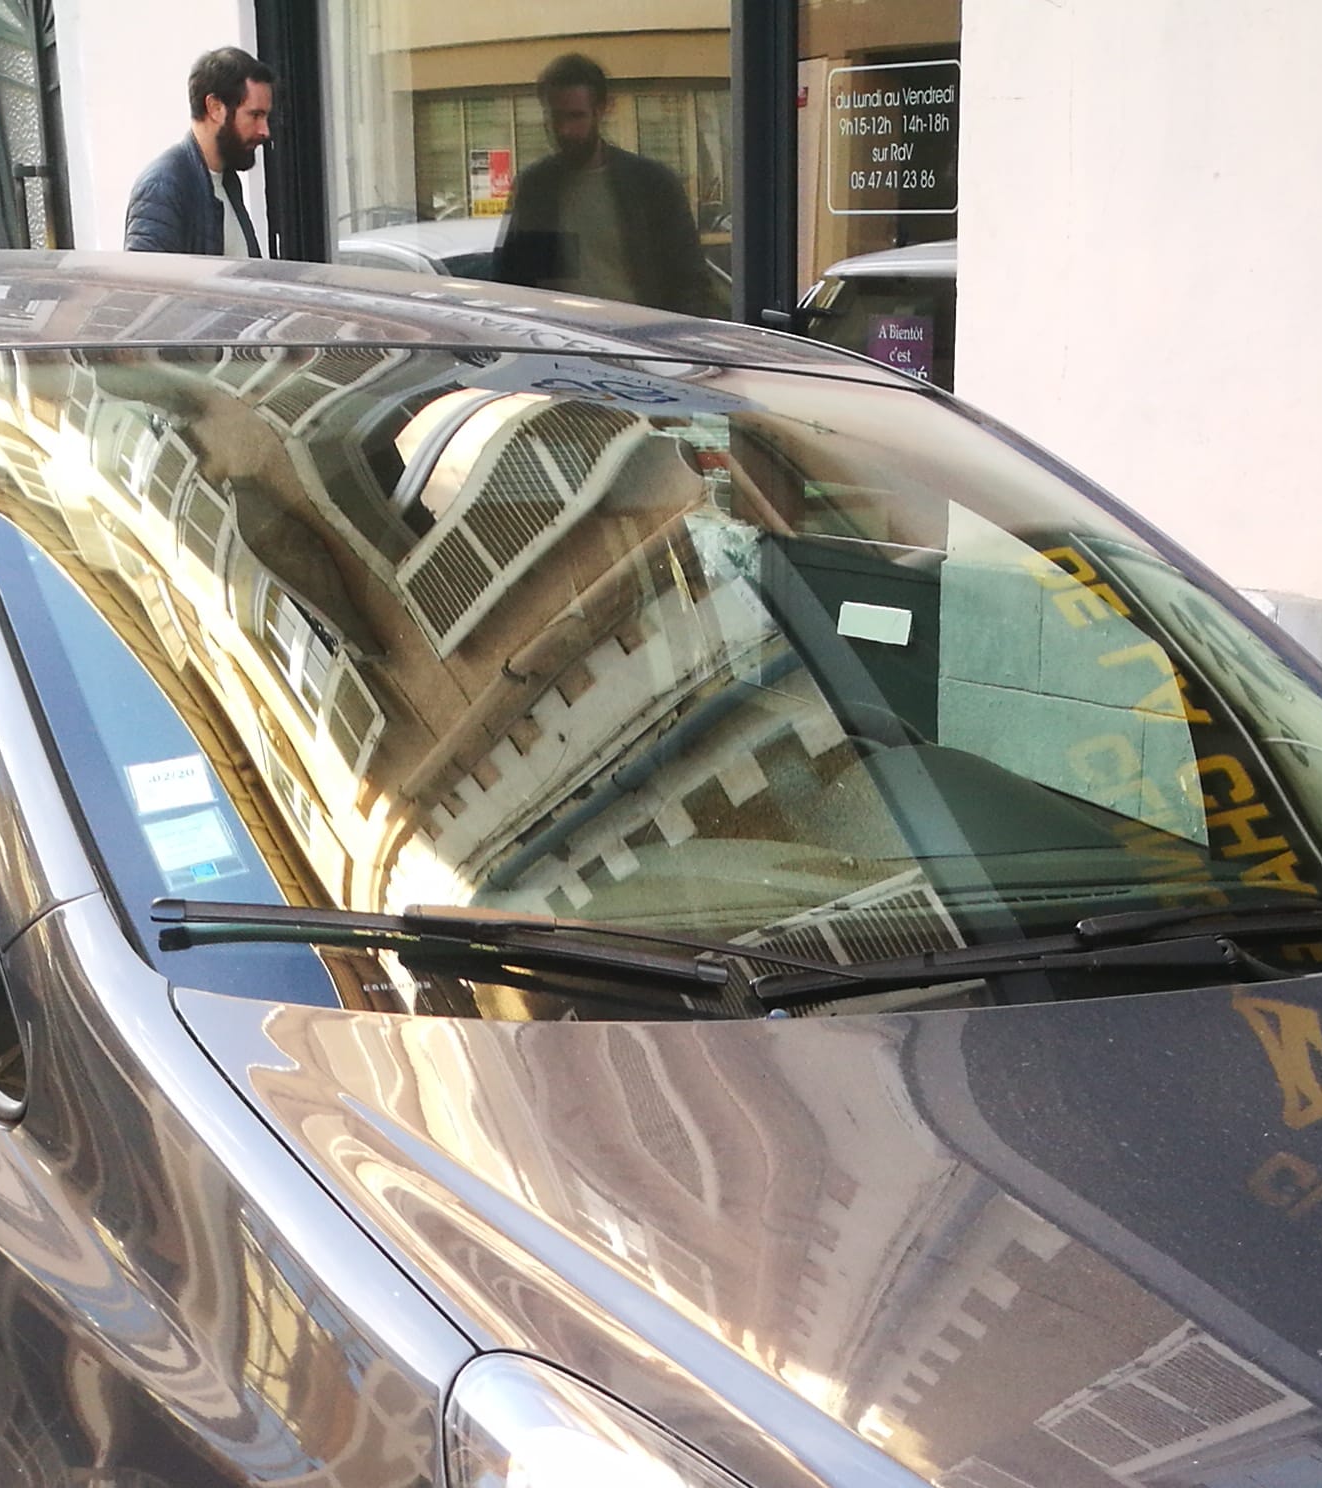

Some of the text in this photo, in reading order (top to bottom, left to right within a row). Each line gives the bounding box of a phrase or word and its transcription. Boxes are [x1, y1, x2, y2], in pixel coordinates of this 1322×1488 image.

[835, 85, 955, 110] du Lundi au Vendredi
[839, 113, 949, 136] 9h15-12h 14h-18h
[872, 143, 914, 162] sur RdV
[850, 169, 936, 190] 05 47 41 23 86
[878, 324, 887, 339] A
[888, 346, 911, 363] c'est
